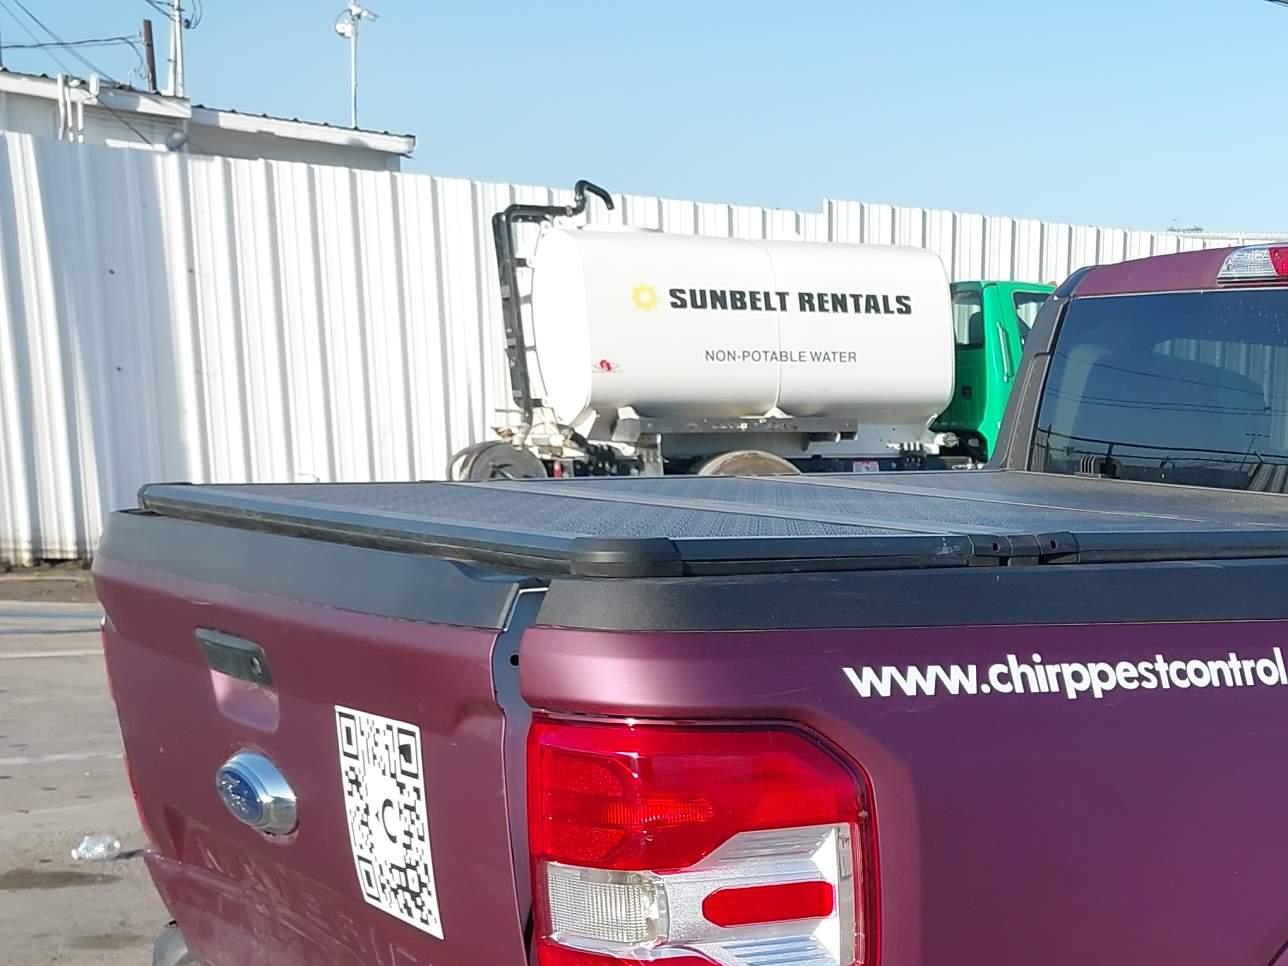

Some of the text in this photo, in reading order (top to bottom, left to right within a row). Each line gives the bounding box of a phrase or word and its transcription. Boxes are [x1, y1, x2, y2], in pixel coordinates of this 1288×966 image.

[669, 288, 912, 315] SUNBELT RENTALS
[705, 350, 857, 363] NON-POTABLE WATER
